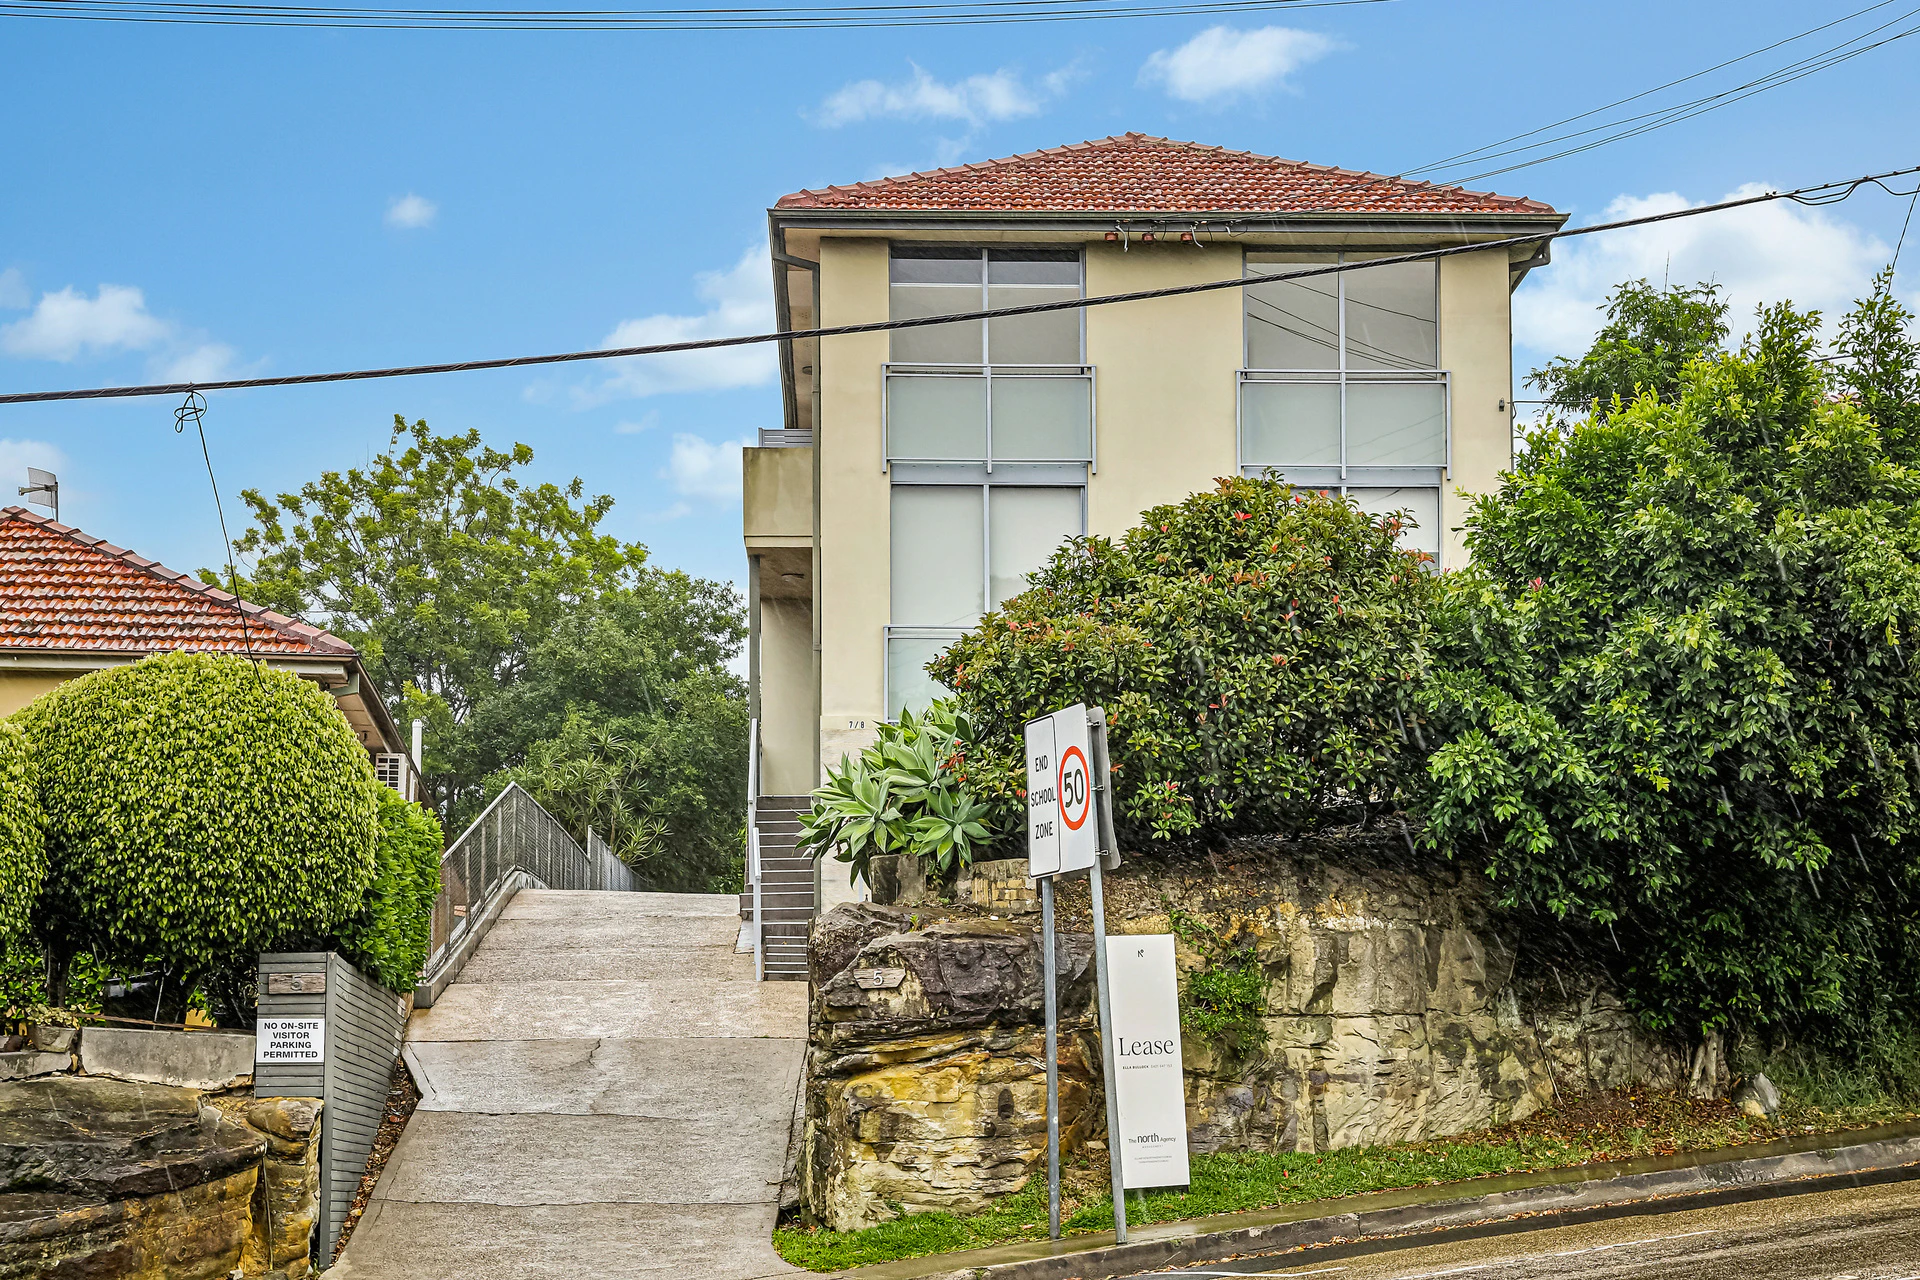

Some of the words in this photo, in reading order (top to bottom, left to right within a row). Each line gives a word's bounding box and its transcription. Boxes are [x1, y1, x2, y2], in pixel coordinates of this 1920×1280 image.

[1035, 754, 1048, 773] END
[1064, 769, 1084, 809] 50
[1031, 787, 1056, 808] SCHOOL
[1035, 820, 1053, 840] ZONE
[291, 975, 302, 991] 5
[873, 971, 883, 986] 5
[264, 1022, 278, 1030] NO
[280, 1022, 319, 1030] ON-SITE
[272, 1031, 310, 1039] VISITOR
[270, 1041, 312, 1049] PARKING
[1118, 1037, 1175, 1057] Lease
[263, 1050, 318, 1059] PERMITTED
[1137, 1132, 1159, 1144] north
